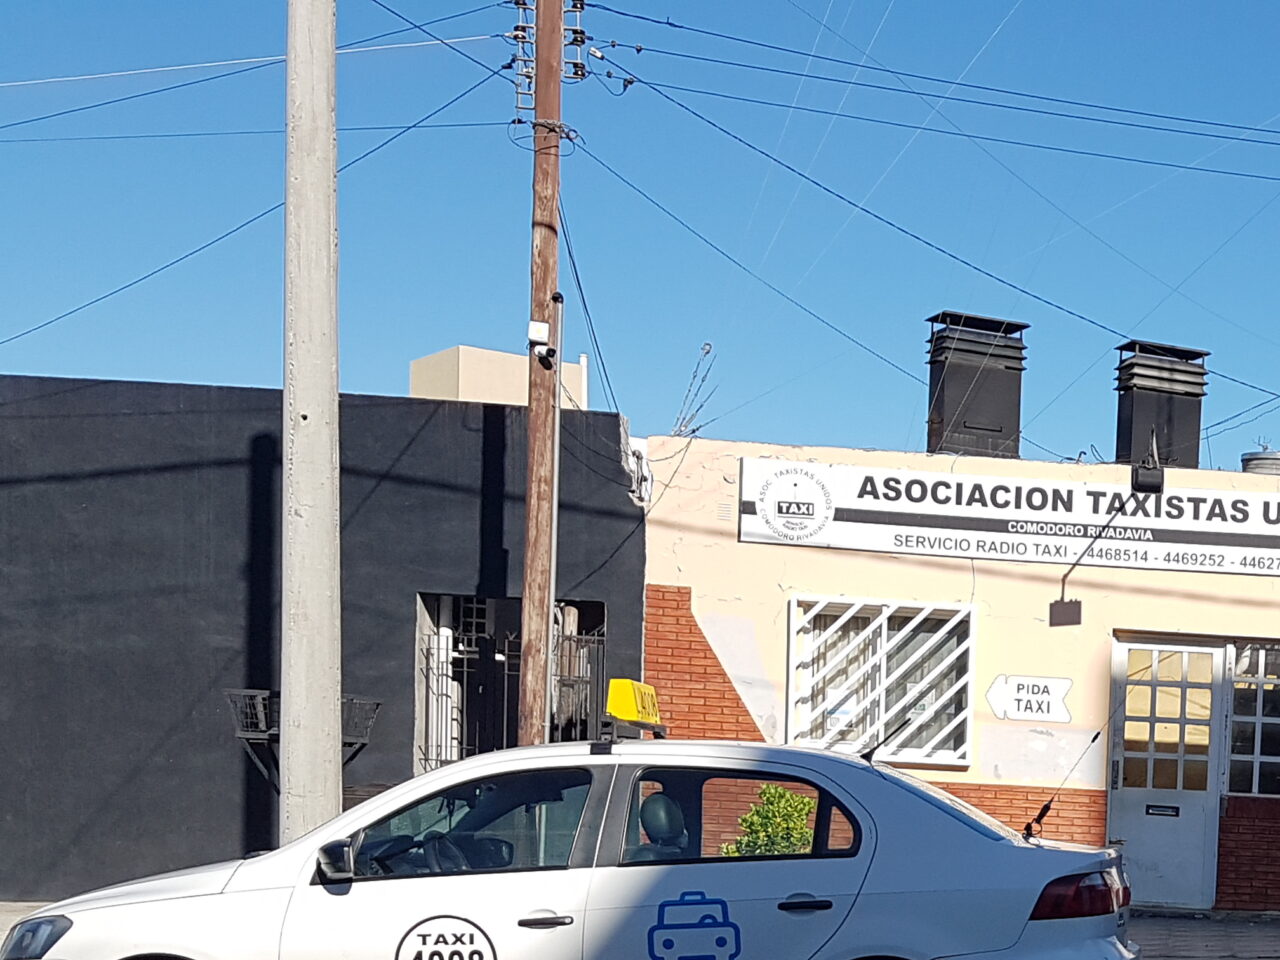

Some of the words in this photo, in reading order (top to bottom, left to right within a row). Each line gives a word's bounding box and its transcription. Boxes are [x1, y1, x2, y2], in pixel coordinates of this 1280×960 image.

[774, 468, 815, 480] TAXISTAS
[816, 479, 832, 511] UNIDOS
[857, 475, 1074, 512] ASOCIACION
[1086, 490, 1250, 523] TAXISTAS
[779, 502, 813, 515] TAXI
[760, 508, 795, 541] COMODORO
[796, 516, 829, 541] RIVADAVIA
[1007, 521, 1084, 537] COMODORO
[1087, 526, 1154, 542] RIVADAVIA
[893, 534, 971, 552] SERVICIO
[976, 540, 1028, 556] RADIO
[1034, 543, 1068, 558] TAXI
[1087, 546, 1149, 562] 4468514
[1163, 552, 1225, 567] 4469252
[1017, 683, 1050, 696] PIDA
[1014, 698, 1050, 714] TAXI
[417, 933, 474, 946] TAXI
